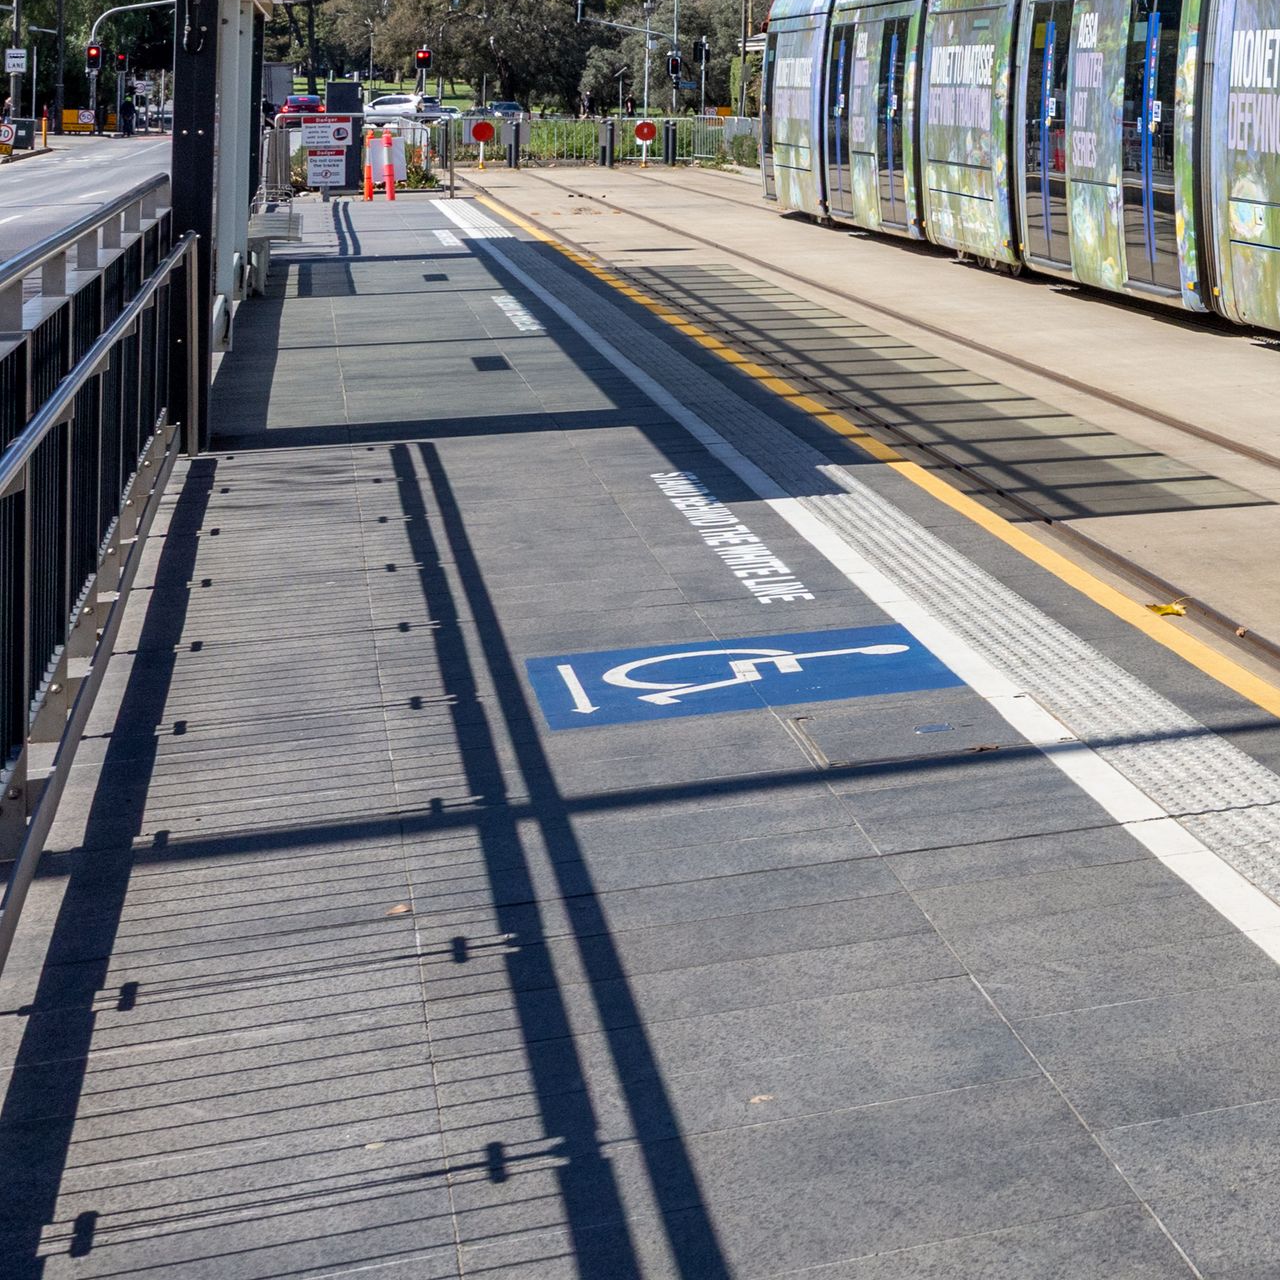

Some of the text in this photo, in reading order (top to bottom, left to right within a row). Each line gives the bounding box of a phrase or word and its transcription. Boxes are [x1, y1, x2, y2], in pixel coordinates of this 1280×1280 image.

[1078, 12, 1099, 48] AGSA
[1075, 52, 1103, 88] WINTER
[1073, 92, 1088, 127] ART
[1072, 131, 1097, 168] SERIES
[650, 472, 816, 604] STAND BEHIND THE WHITE LINE
